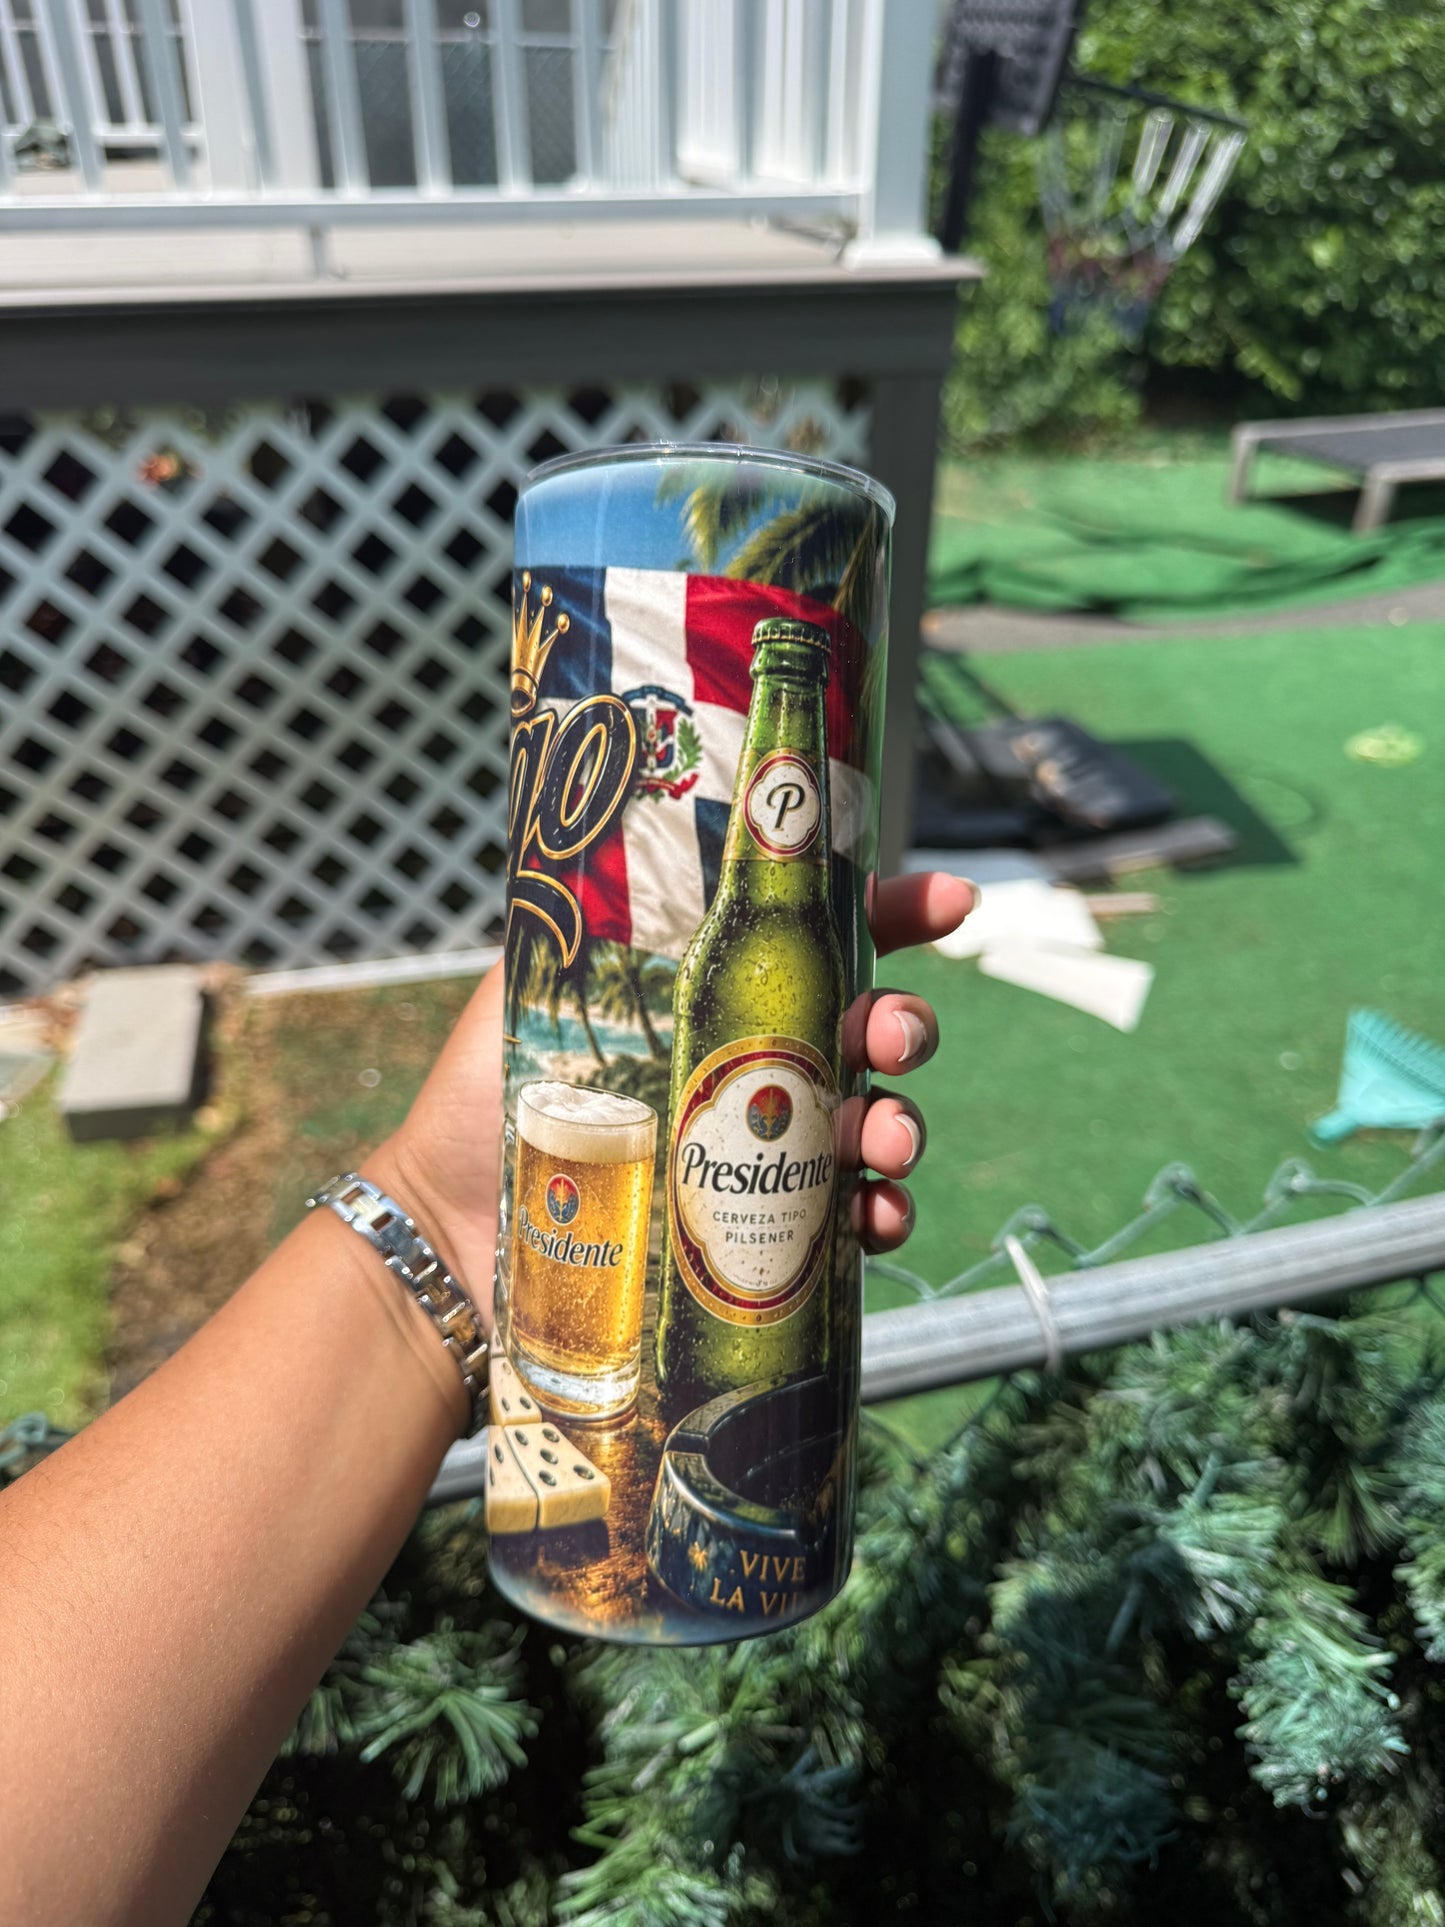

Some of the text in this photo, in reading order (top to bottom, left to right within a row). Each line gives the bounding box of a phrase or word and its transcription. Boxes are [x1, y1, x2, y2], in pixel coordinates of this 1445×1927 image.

[766, 782, 806, 832] P
[681, 1142, 832, 1195] Presidente
[713, 1208, 807, 1225] CERVEZA TIPO
[519, 1205, 624, 1268] Presidente
[725, 1229, 794, 1245] PILSENER
[740, 1549, 806, 1582] VIVE
[709, 1577, 745, 1614] LA
